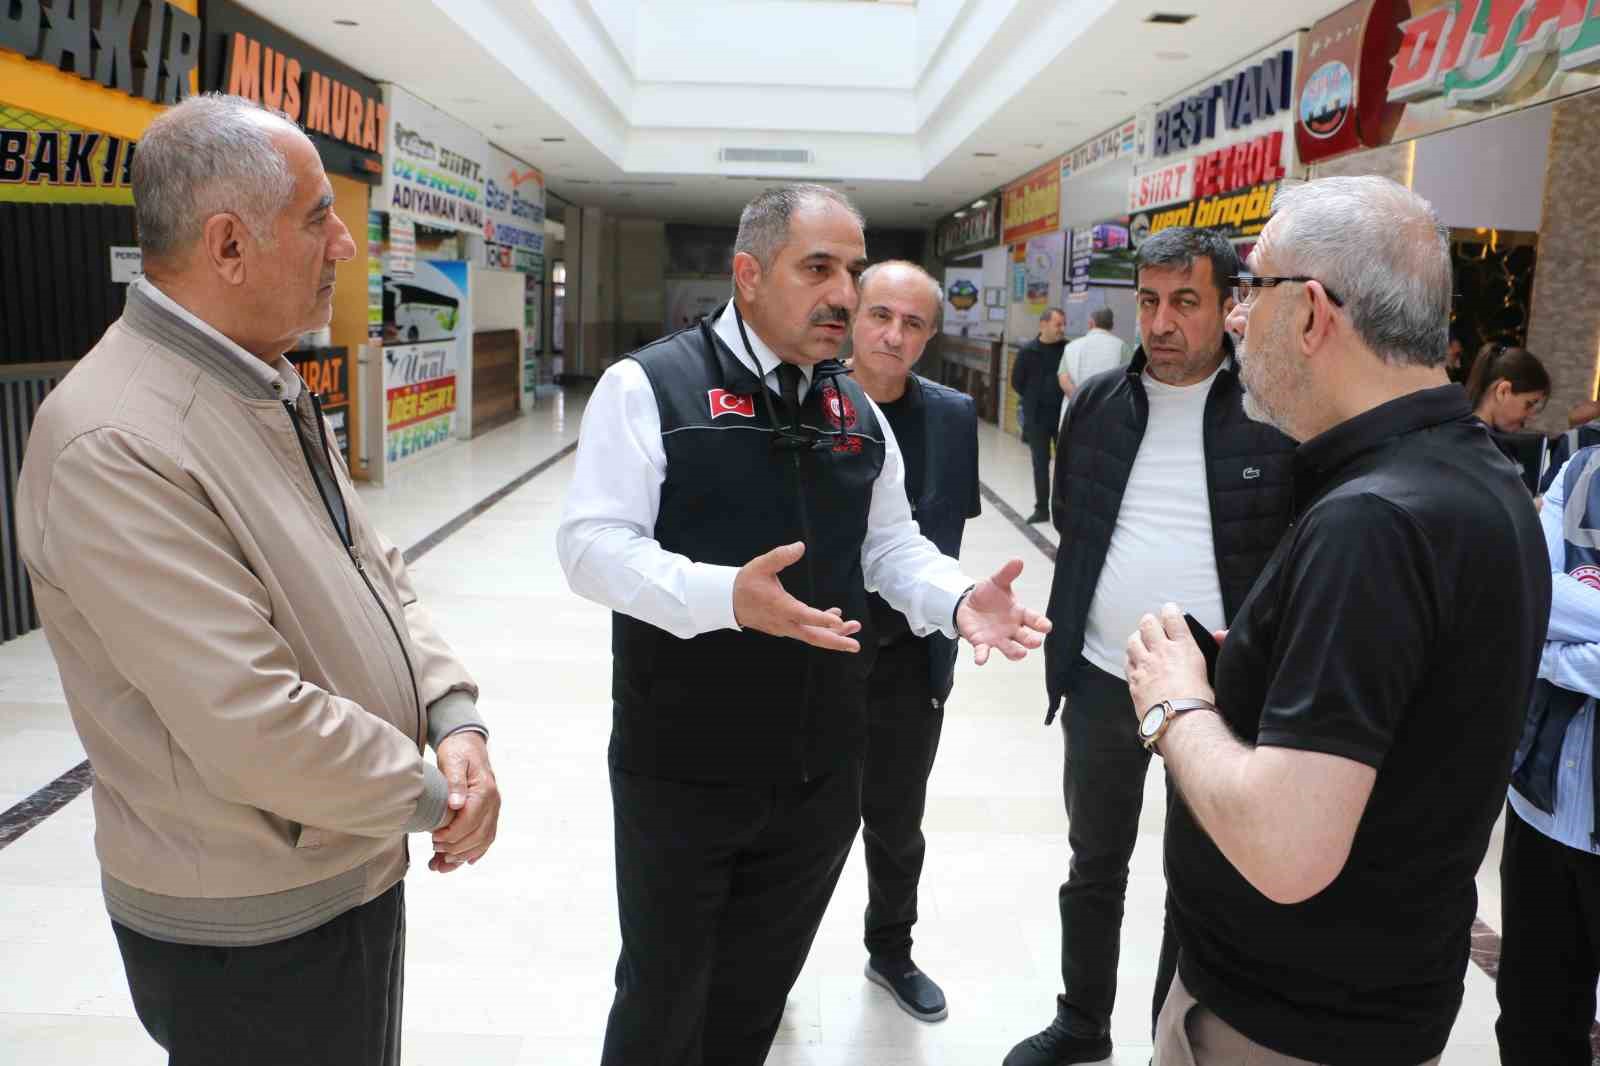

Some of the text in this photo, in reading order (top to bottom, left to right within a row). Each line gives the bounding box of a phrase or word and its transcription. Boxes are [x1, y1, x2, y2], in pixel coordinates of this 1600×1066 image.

[307, 71, 388, 155] MURAT
[1152, 49, 1293, 158] BEST VAN
[391, 183, 457, 222] ADIYAMAN
